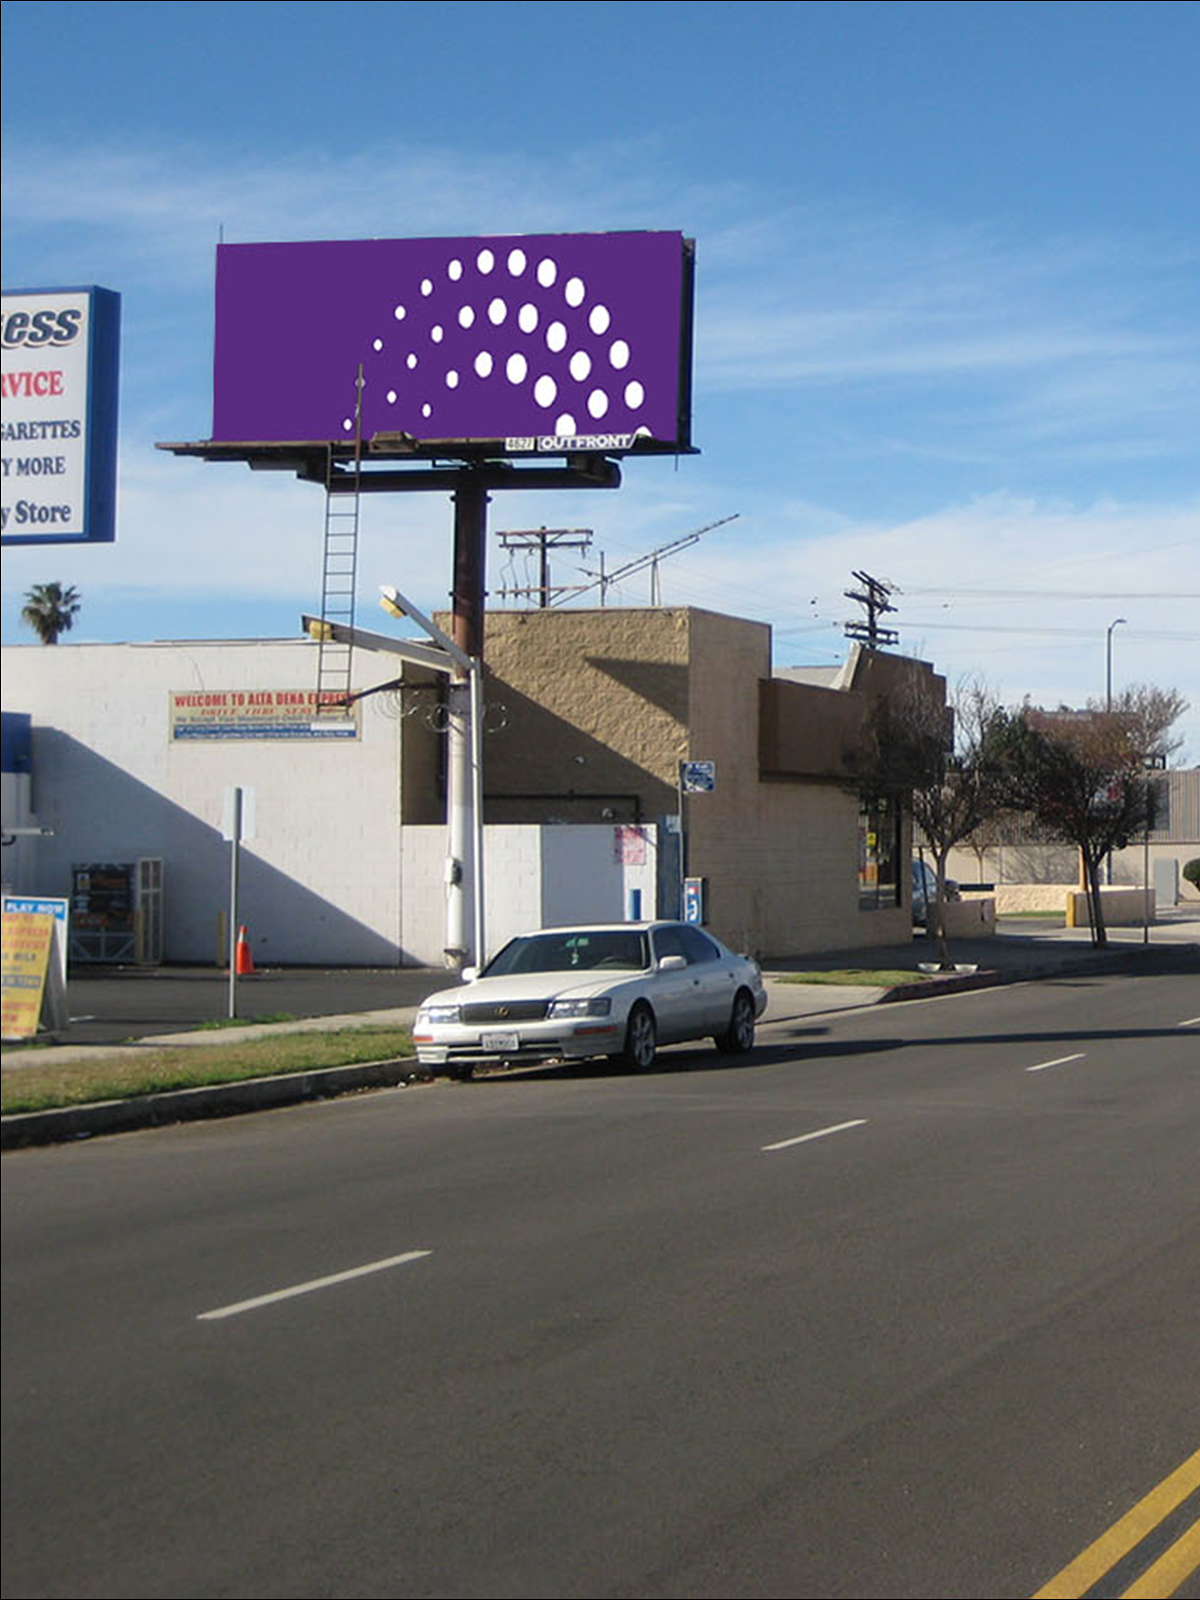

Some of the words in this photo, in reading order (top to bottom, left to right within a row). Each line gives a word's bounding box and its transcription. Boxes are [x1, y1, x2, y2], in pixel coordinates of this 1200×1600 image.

[1, 308, 82, 350] ess
[541, 434, 631, 449] OUTFRONT
[16, 456, 66, 476] MORE
[15, 499, 71, 523] Store
[174, 694, 227, 707] WELCOME
[231, 693, 245, 706] TO
[248, 692, 273, 706] ALTA
[276, 692, 305, 705] DENA
[308, 692, 354, 705] EXPRE
[6, 902, 34, 912] PLAY
[39, 903, 65, 913] NOW
